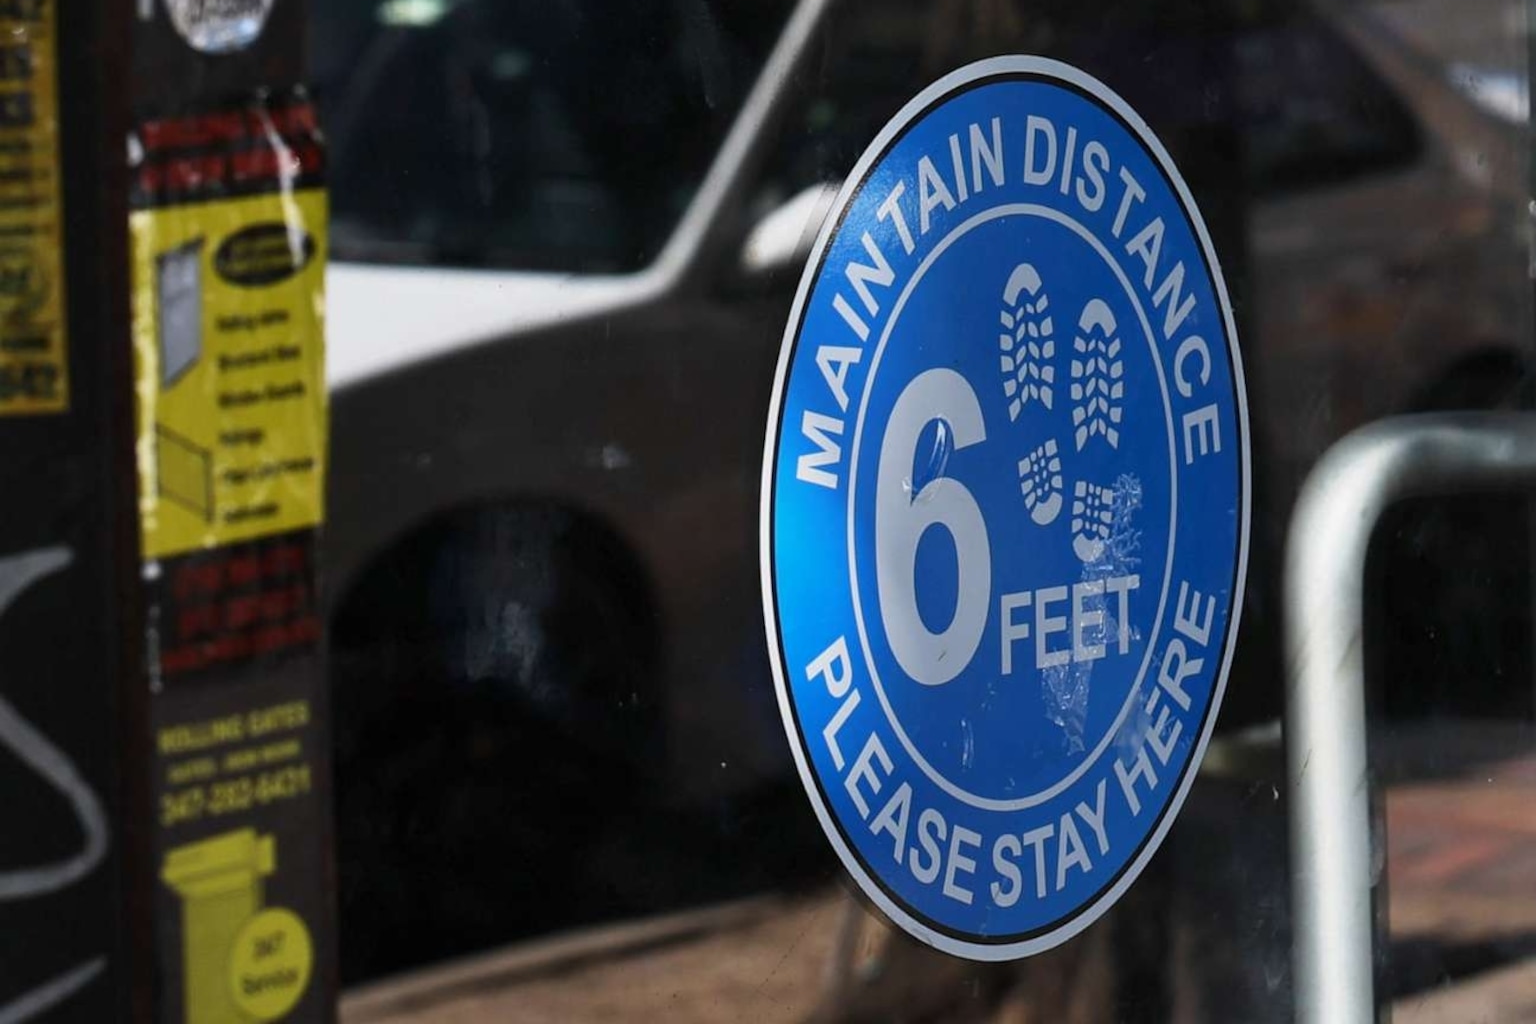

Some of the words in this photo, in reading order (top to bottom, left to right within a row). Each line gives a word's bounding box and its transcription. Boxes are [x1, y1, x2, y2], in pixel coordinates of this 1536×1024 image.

[796, 116, 1005, 490] MAINTAIN
[1023, 114, 1222, 466] DISTANCE
[875, 367, 993, 686] 6
[1000, 574, 1141, 676] FEET
[806, 634, 983, 906] PLEASE
[990, 777, 1110, 908] STAY
[1112, 579, 1217, 817] HERE
